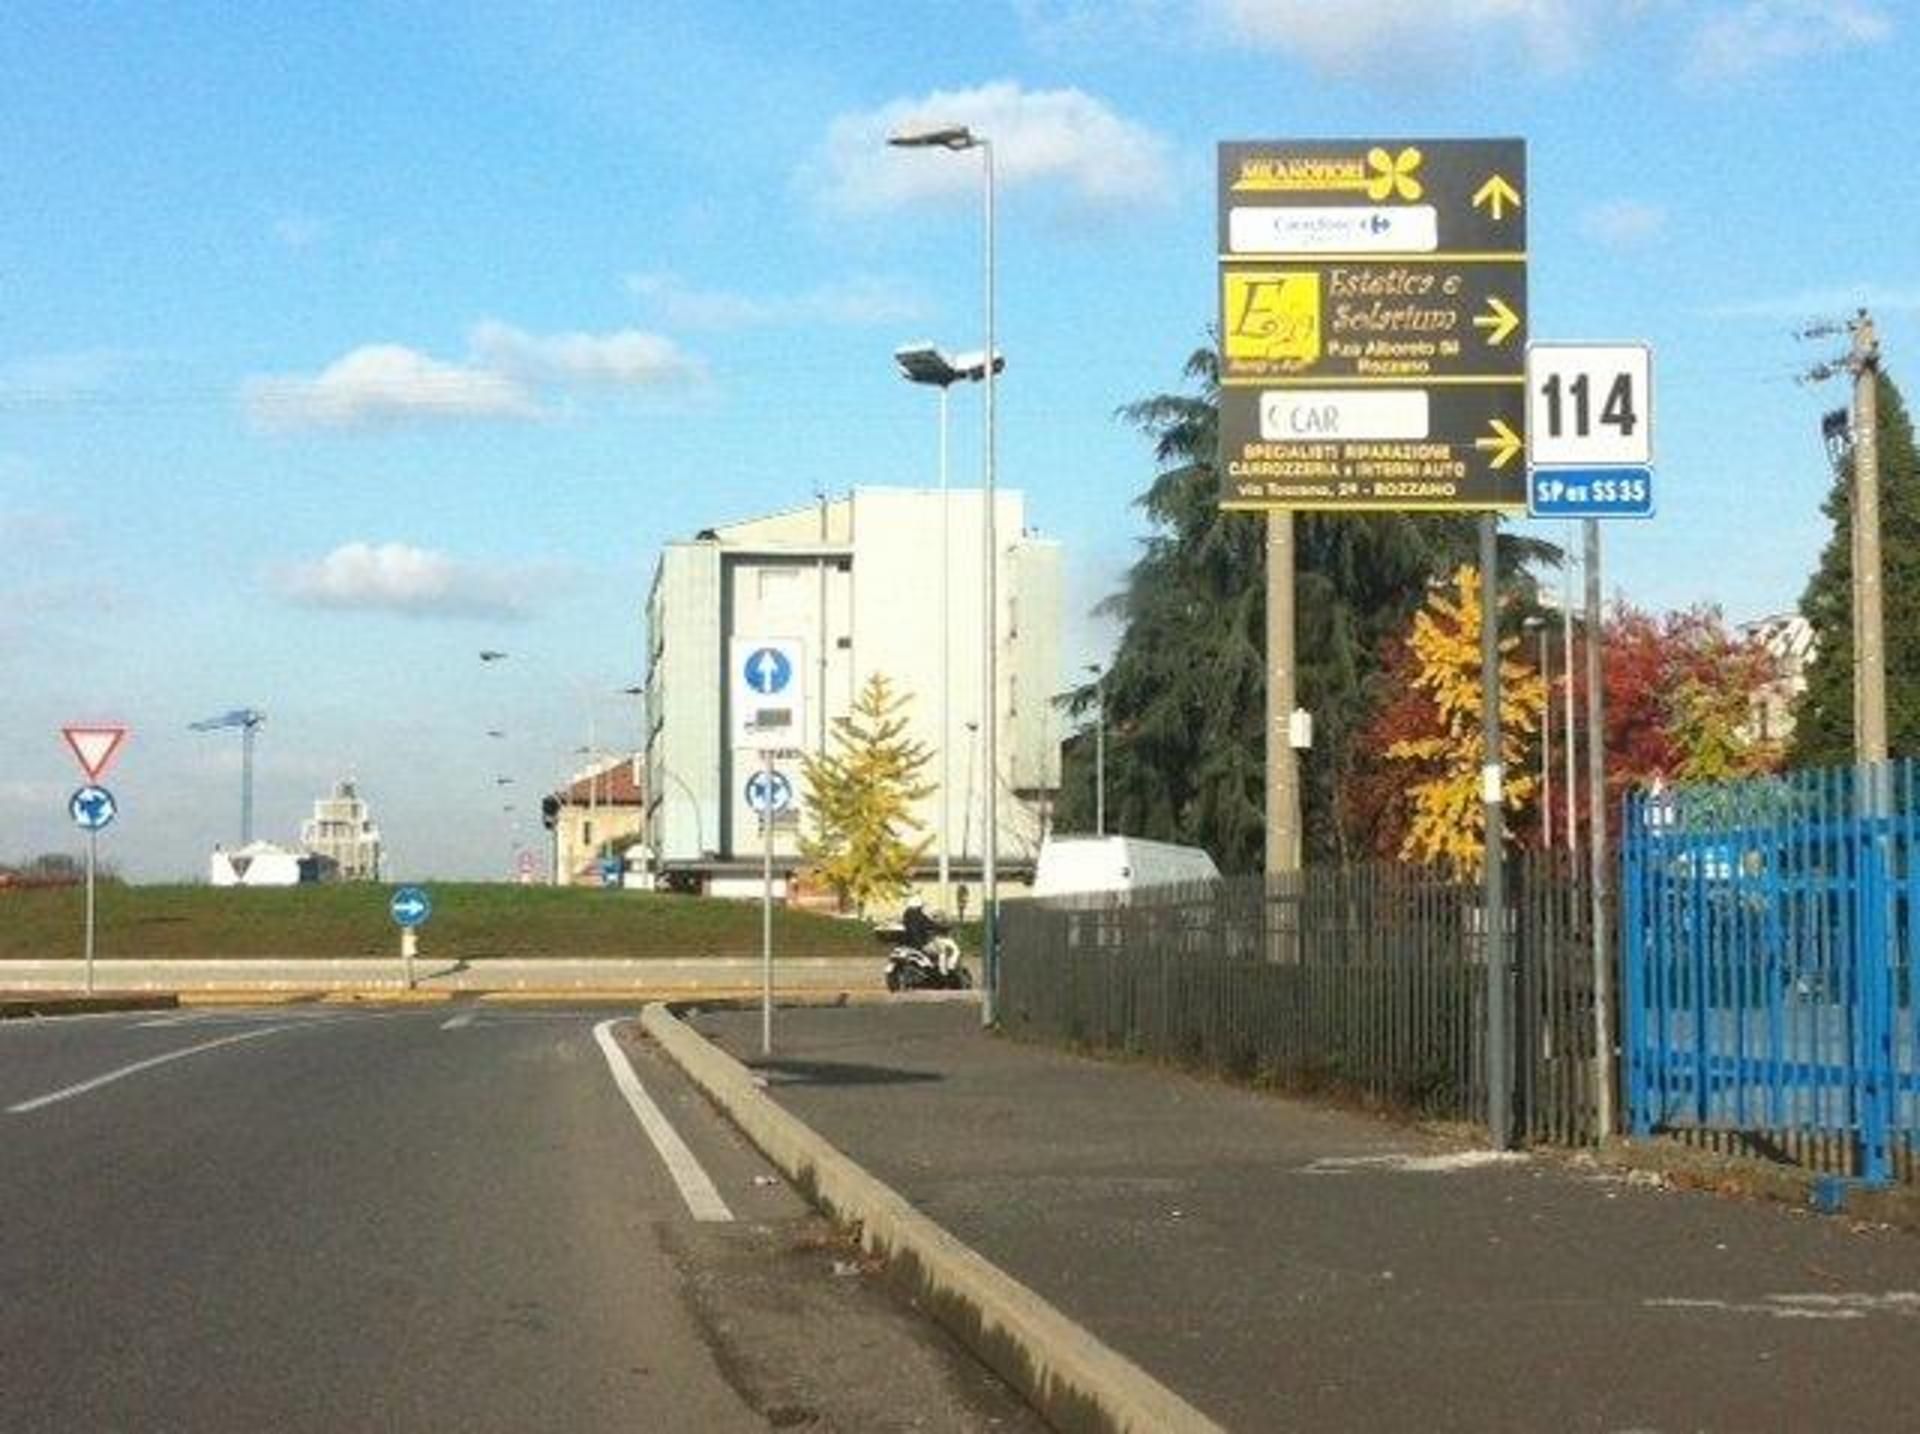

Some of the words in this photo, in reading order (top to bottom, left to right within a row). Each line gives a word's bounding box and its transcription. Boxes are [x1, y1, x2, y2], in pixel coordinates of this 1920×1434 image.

[1328, 269, 1435, 297] Estetica
[1443, 274, 1461, 294] e
[1332, 301, 1457, 331] Solarium
[1541, 372, 1637, 438] 114
[1290, 404, 1340, 433] CAR
[1243, 443, 1339, 460] SPECIALISTI
[1228, 461, 1338, 478] CARROZZERIA
[1355, 461, 1420, 478] INTERNI
[1422, 461, 1465, 478] AUTO
[1373, 482, 1457, 497] ROZZANO
[1537, 480, 1563, 502] SP
